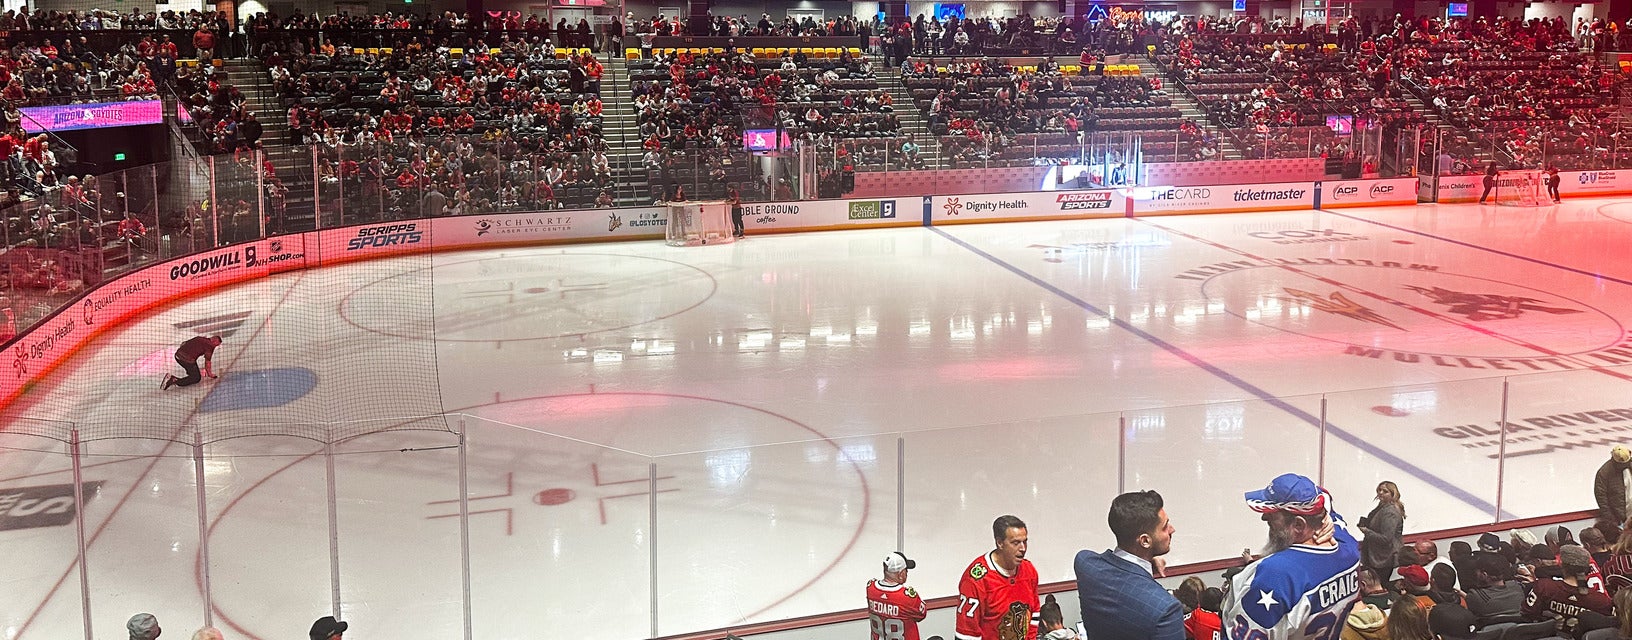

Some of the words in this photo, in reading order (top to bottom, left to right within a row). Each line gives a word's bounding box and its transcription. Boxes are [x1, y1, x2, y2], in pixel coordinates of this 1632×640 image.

[54, 111, 85, 125] ARIZONA
[91, 109, 123, 121] COYOTES
[1450, 181, 1476, 190] Children's
[1060, 193, 1106, 202] ARIZONA
[1234, 189, 1306, 202] ticketmaster
[740, 207, 761, 216] OBLE
[765, 205, 800, 214] GROUND
[851, 203, 875, 212] Excel
[966, 201, 997, 212] Dignity
[999, 199, 1028, 209] Health
[1064, 200, 1107, 209] SPORTS
[496, 217, 571, 226] SCHWARTZ
[756, 216, 776, 224] coffee
[850, 210, 879, 218] Center
[358, 224, 416, 237] SCRIPPS
[347, 231, 423, 250] SPORTS
[170, 252, 240, 280] GOODWILL
[94, 290, 122, 312] EQUALITY
[124, 279, 151, 297] HEALTH
[31, 335, 55, 359] Dignity
[54, 318, 75, 343] Health
[1344, 345, 1576, 370] MULLETT
[1432, 420, 1533, 440] GILA
[1318, 570, 1359, 608] CRAIG
[869, 600, 899, 616] BEDARD
[957, 594, 980, 618] 77
[1550, 600, 1592, 617] COYOT
[869, 613, 905, 640] 98
